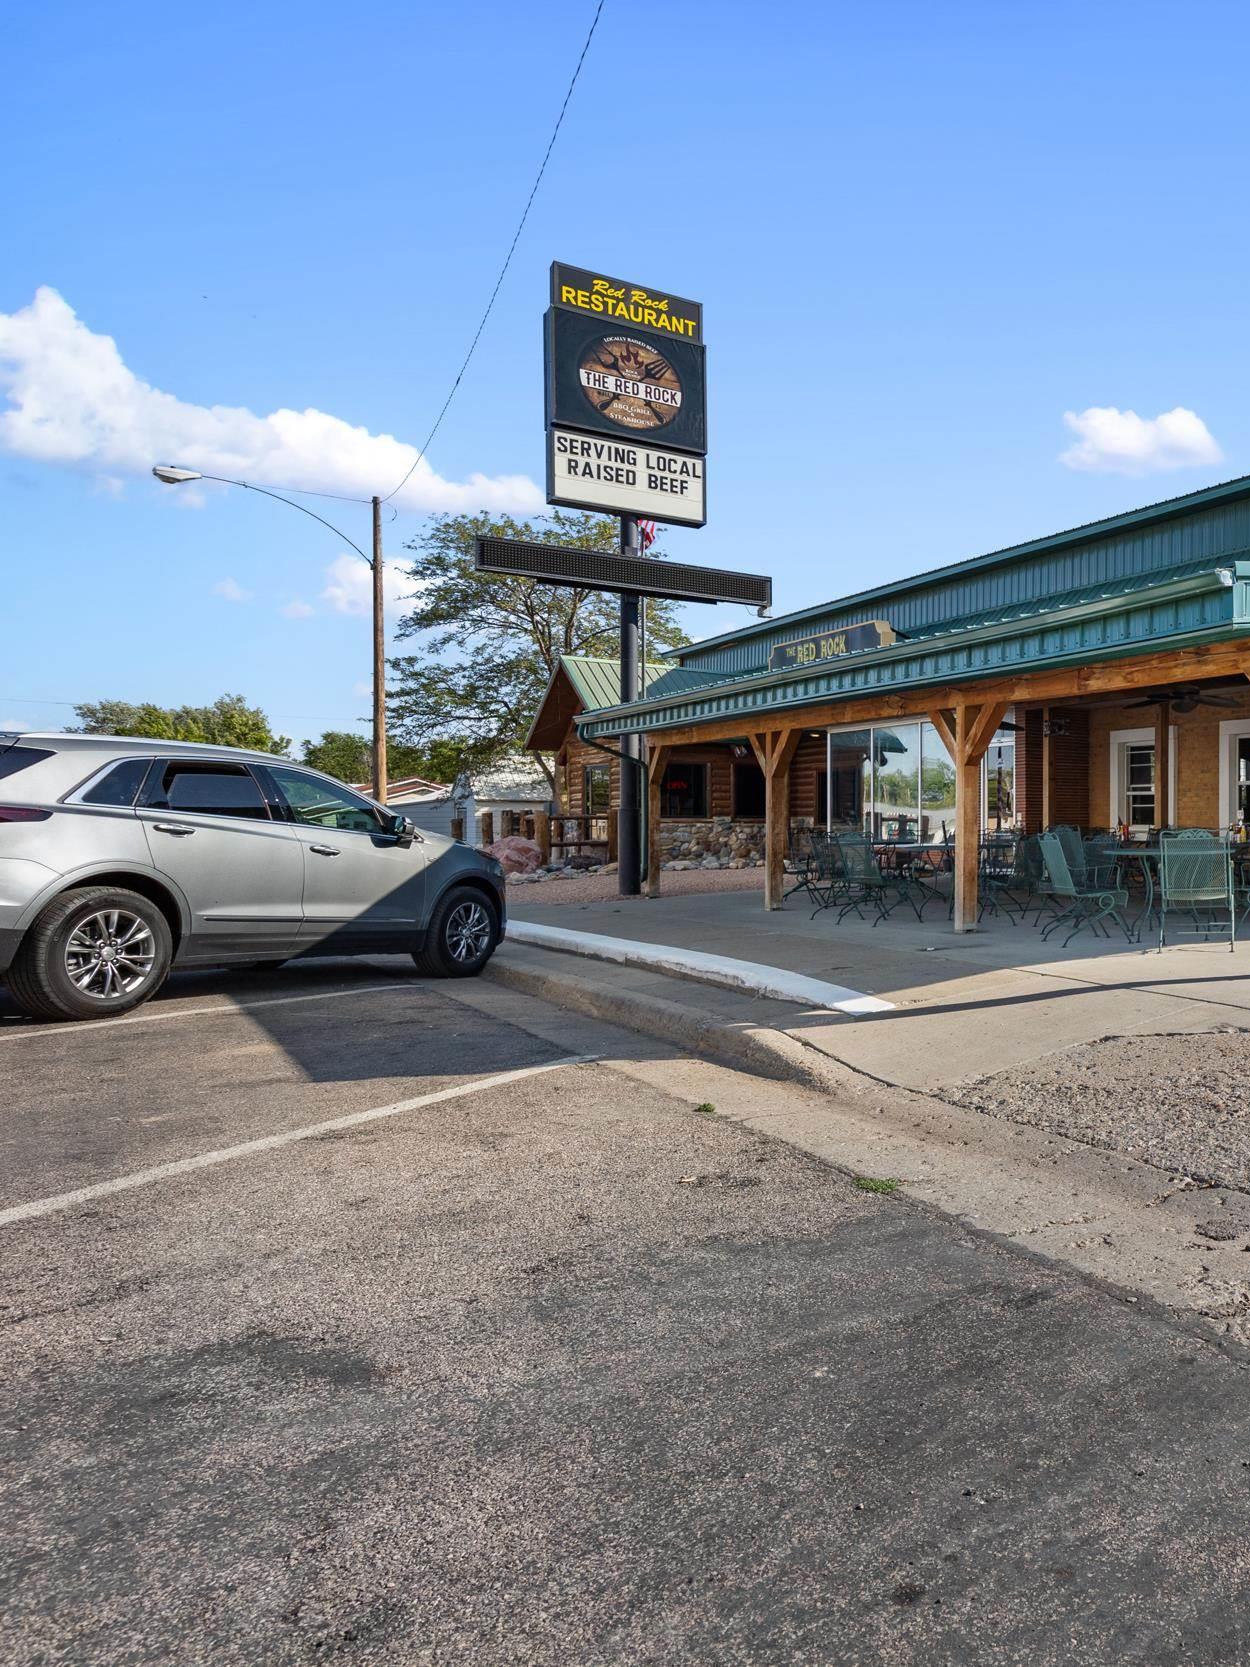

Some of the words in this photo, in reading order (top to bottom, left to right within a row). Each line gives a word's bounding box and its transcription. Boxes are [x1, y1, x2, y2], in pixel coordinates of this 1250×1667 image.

[561, 285, 697, 337] RESTAURANT
[593, 279, 625, 299] Red
[631, 290, 669, 311] Rock
[627, 337, 646, 348] RAISED
[646, 344, 658, 354] BEEF
[584, 370, 609, 389] THE
[615, 378, 640, 396] RED
[644, 385, 679, 405] ROCK
[609, 412, 655, 426] STEAKHOUSE
[613, 402, 631, 413] BBQ
[630, 406, 652, 416] GRILL
[556, 436, 637, 466] SERVING
[645, 453, 702, 479] LOCAL
[567, 457, 637, 486] RAISED
[647, 473, 689, 495] BEEF
[786, 647, 797, 657] THE
[797, 643, 816, 662] RED
[820, 634, 846, 658] ROCK
